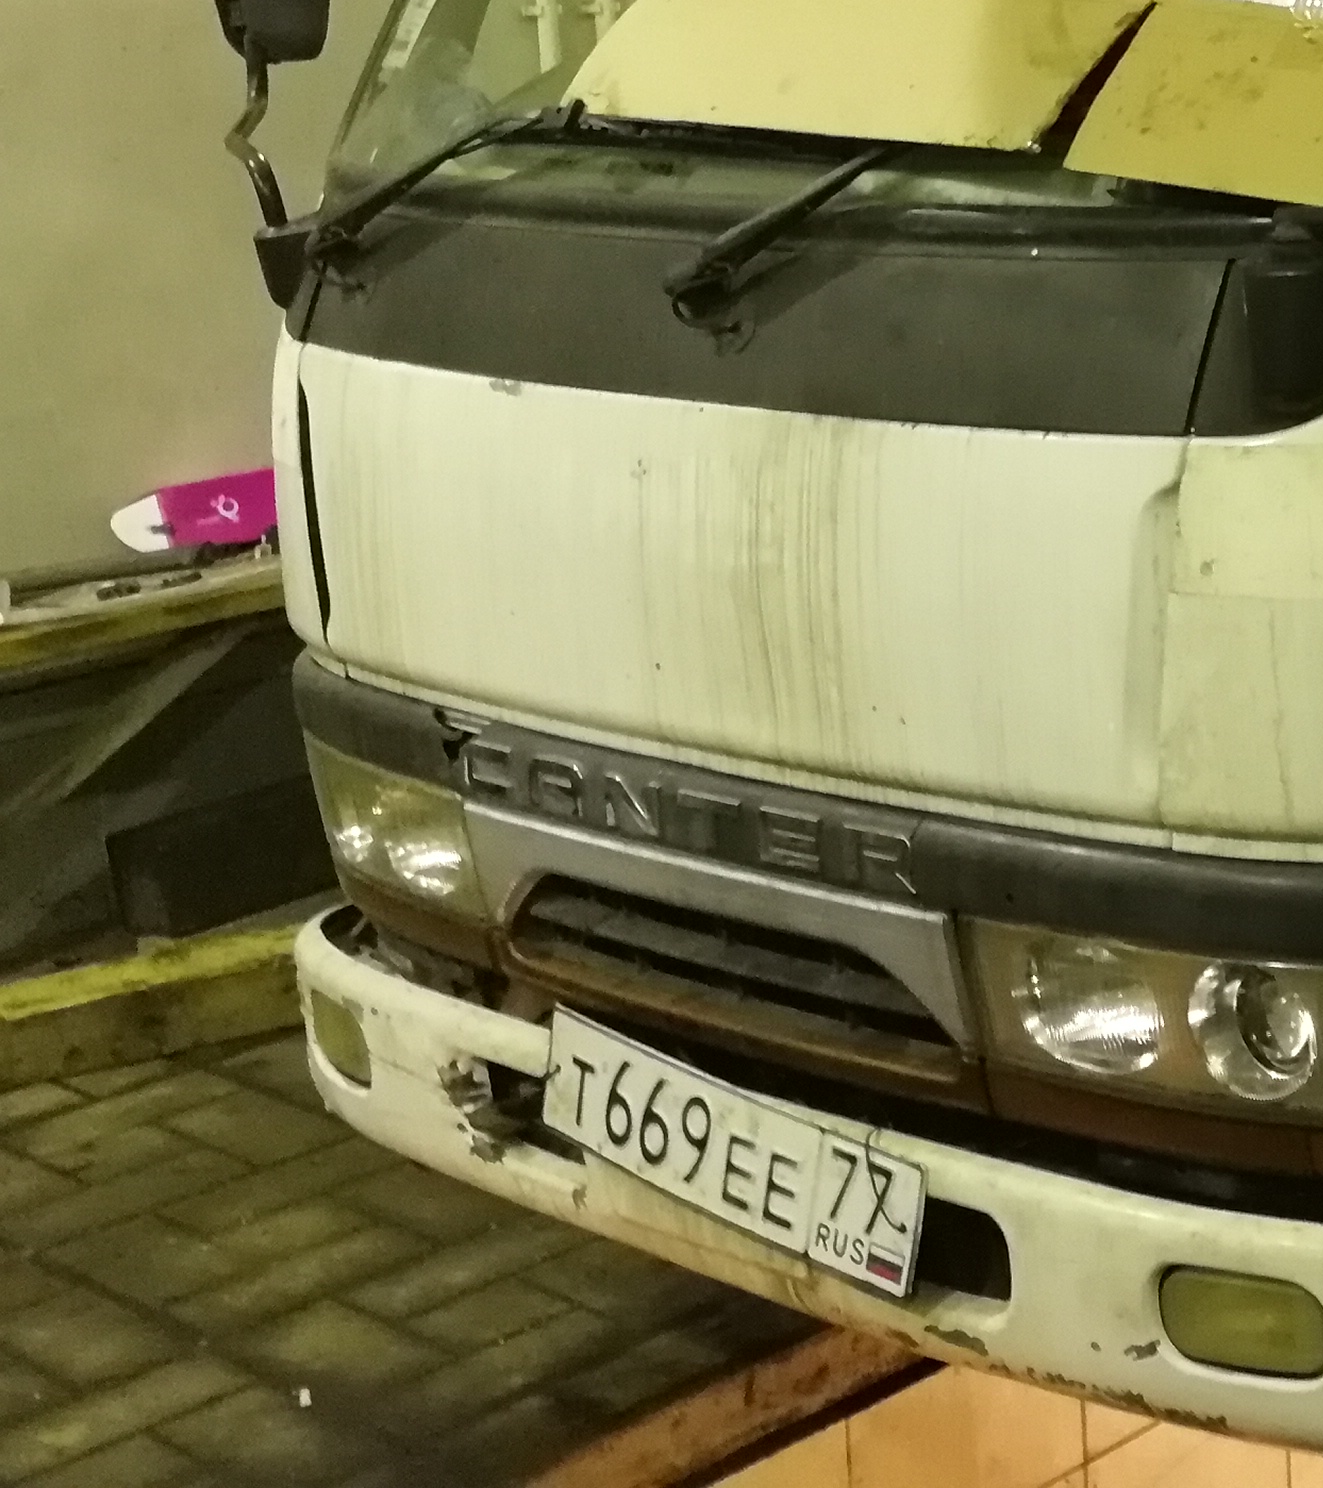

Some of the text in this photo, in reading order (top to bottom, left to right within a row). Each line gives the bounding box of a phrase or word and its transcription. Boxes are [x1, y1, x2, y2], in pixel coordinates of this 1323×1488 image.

[463, 740, 918, 896] CANTER
[829, 1146, 901, 1235] 77
[815, 1222, 866, 1267] RUS
